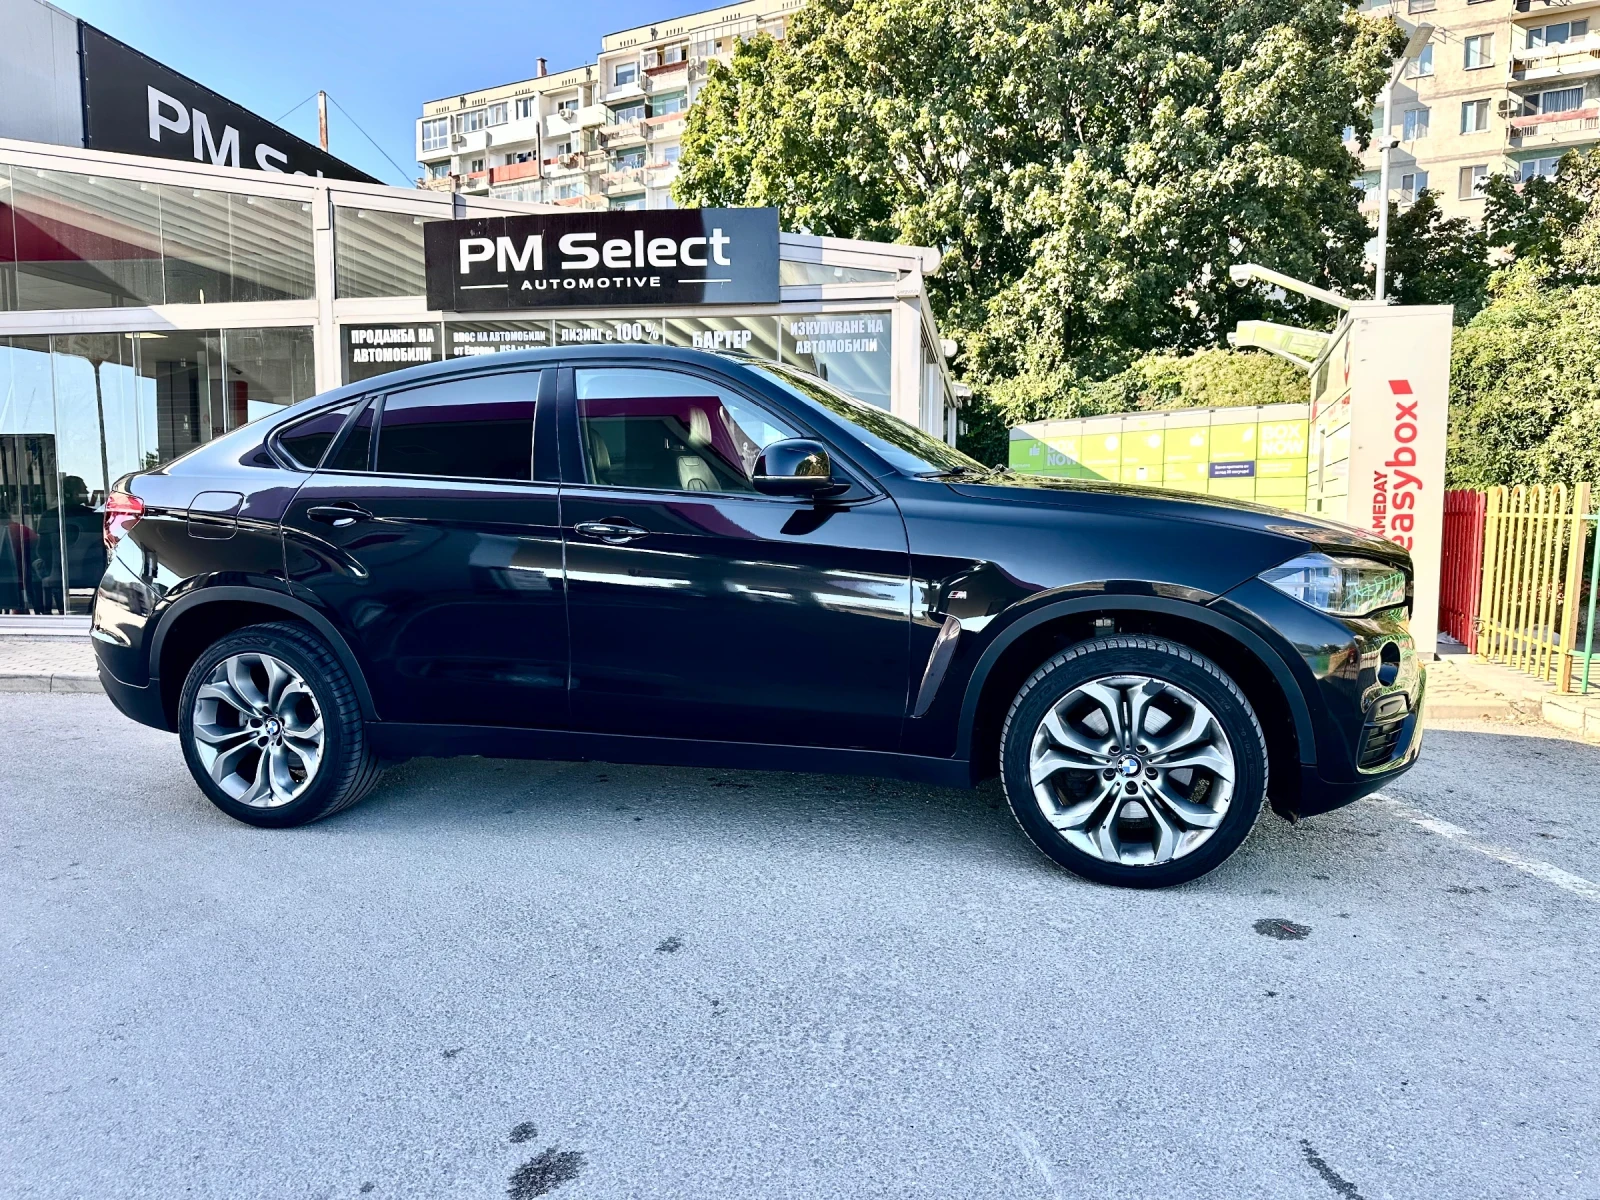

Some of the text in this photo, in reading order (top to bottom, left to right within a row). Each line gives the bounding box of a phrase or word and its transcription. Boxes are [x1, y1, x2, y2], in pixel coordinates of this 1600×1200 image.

[147, 85, 241, 168] PM
[459, 228, 731, 275] PM Select
[521, 276, 661, 291] AUTOMOTIVE
[561, 328, 603, 341] ЛИЗИНГ
[615, 323, 642, 340] 100
[645, 322, 659, 340] %
[790, 319, 883, 336] ИЗКУПУВАНЕ НА
[351, 328, 434, 345] ПРОДАЖБА НА
[477, 331, 488, 342] НА
[489, 331, 546, 342] АВТОМОБИЛИ
[692, 330, 751, 349] БАРТЕР
[353, 347, 431, 362] АВТОМОБИЛИ
[795, 338, 877, 354] АВТОМОБИЛИ
[1261, 423, 1302, 440] BOX
[1261, 438, 1305, 456] NOW
[1046, 452, 1078, 466] NOW
[1385, 400, 1423, 552] easybox
[1372, 470, 1388, 537] MEDAY
